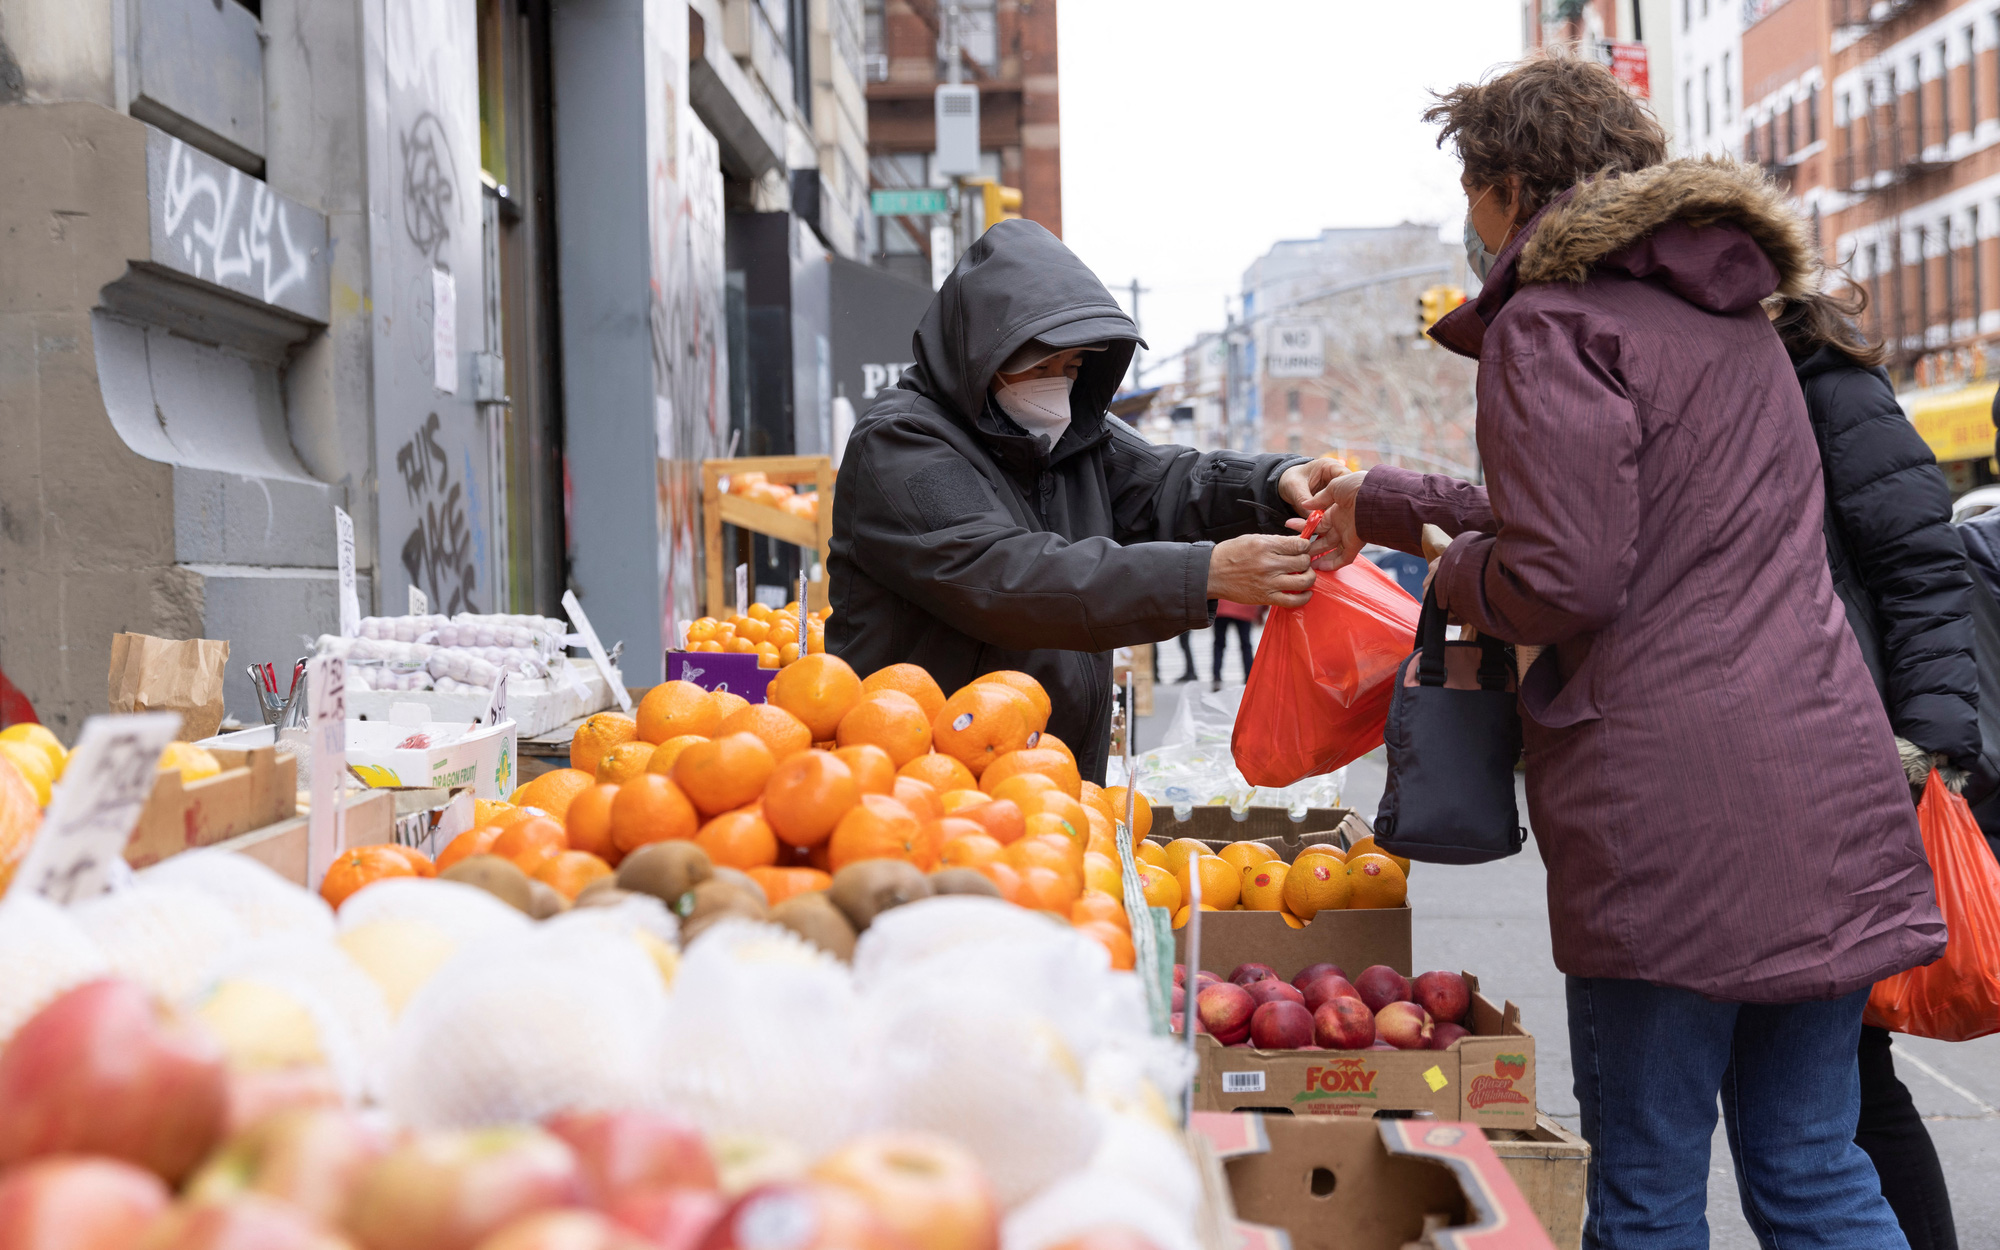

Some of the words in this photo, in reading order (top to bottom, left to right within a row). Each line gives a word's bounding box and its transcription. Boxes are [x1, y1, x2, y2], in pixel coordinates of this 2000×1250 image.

[1282, 330, 1312, 349] NO
[861, 363, 918, 399] PI
[432, 771, 460, 787] DRAGON
[1306, 1066, 1379, 1092] FOXY
[1472, 1077, 1511, 1091] Blazer
[1468, 1089, 1520, 1106] Wilkinson
